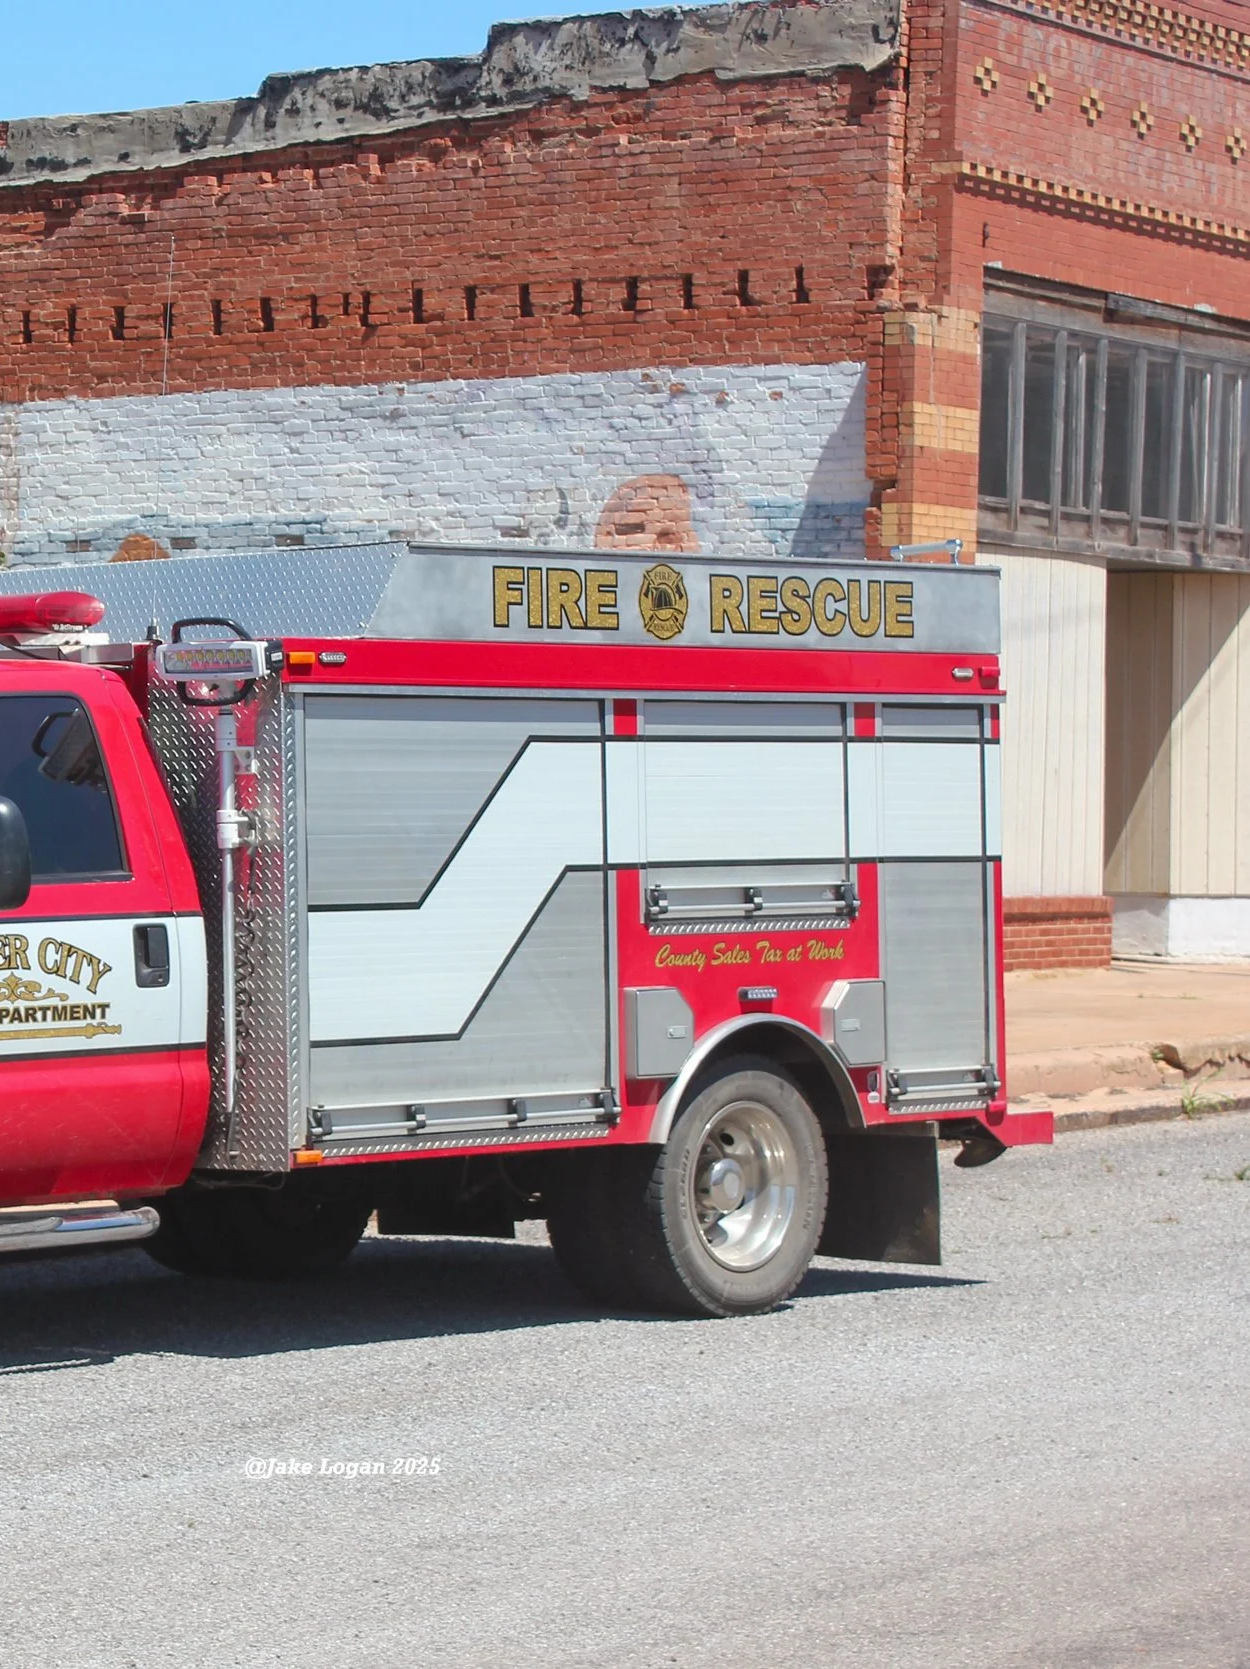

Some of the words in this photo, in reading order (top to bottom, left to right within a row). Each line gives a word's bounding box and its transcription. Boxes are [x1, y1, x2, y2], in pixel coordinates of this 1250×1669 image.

[492, 565, 619, 629] FIRE
[709, 573, 915, 639] RESCUE
[37, 937, 112, 994] CITY
[655, 943, 707, 972] County
[710, 942, 751, 966] Sales
[756, 940, 782, 964] Tax
[786, 944, 803, 961] at
[807, 938, 845, 960] Work
